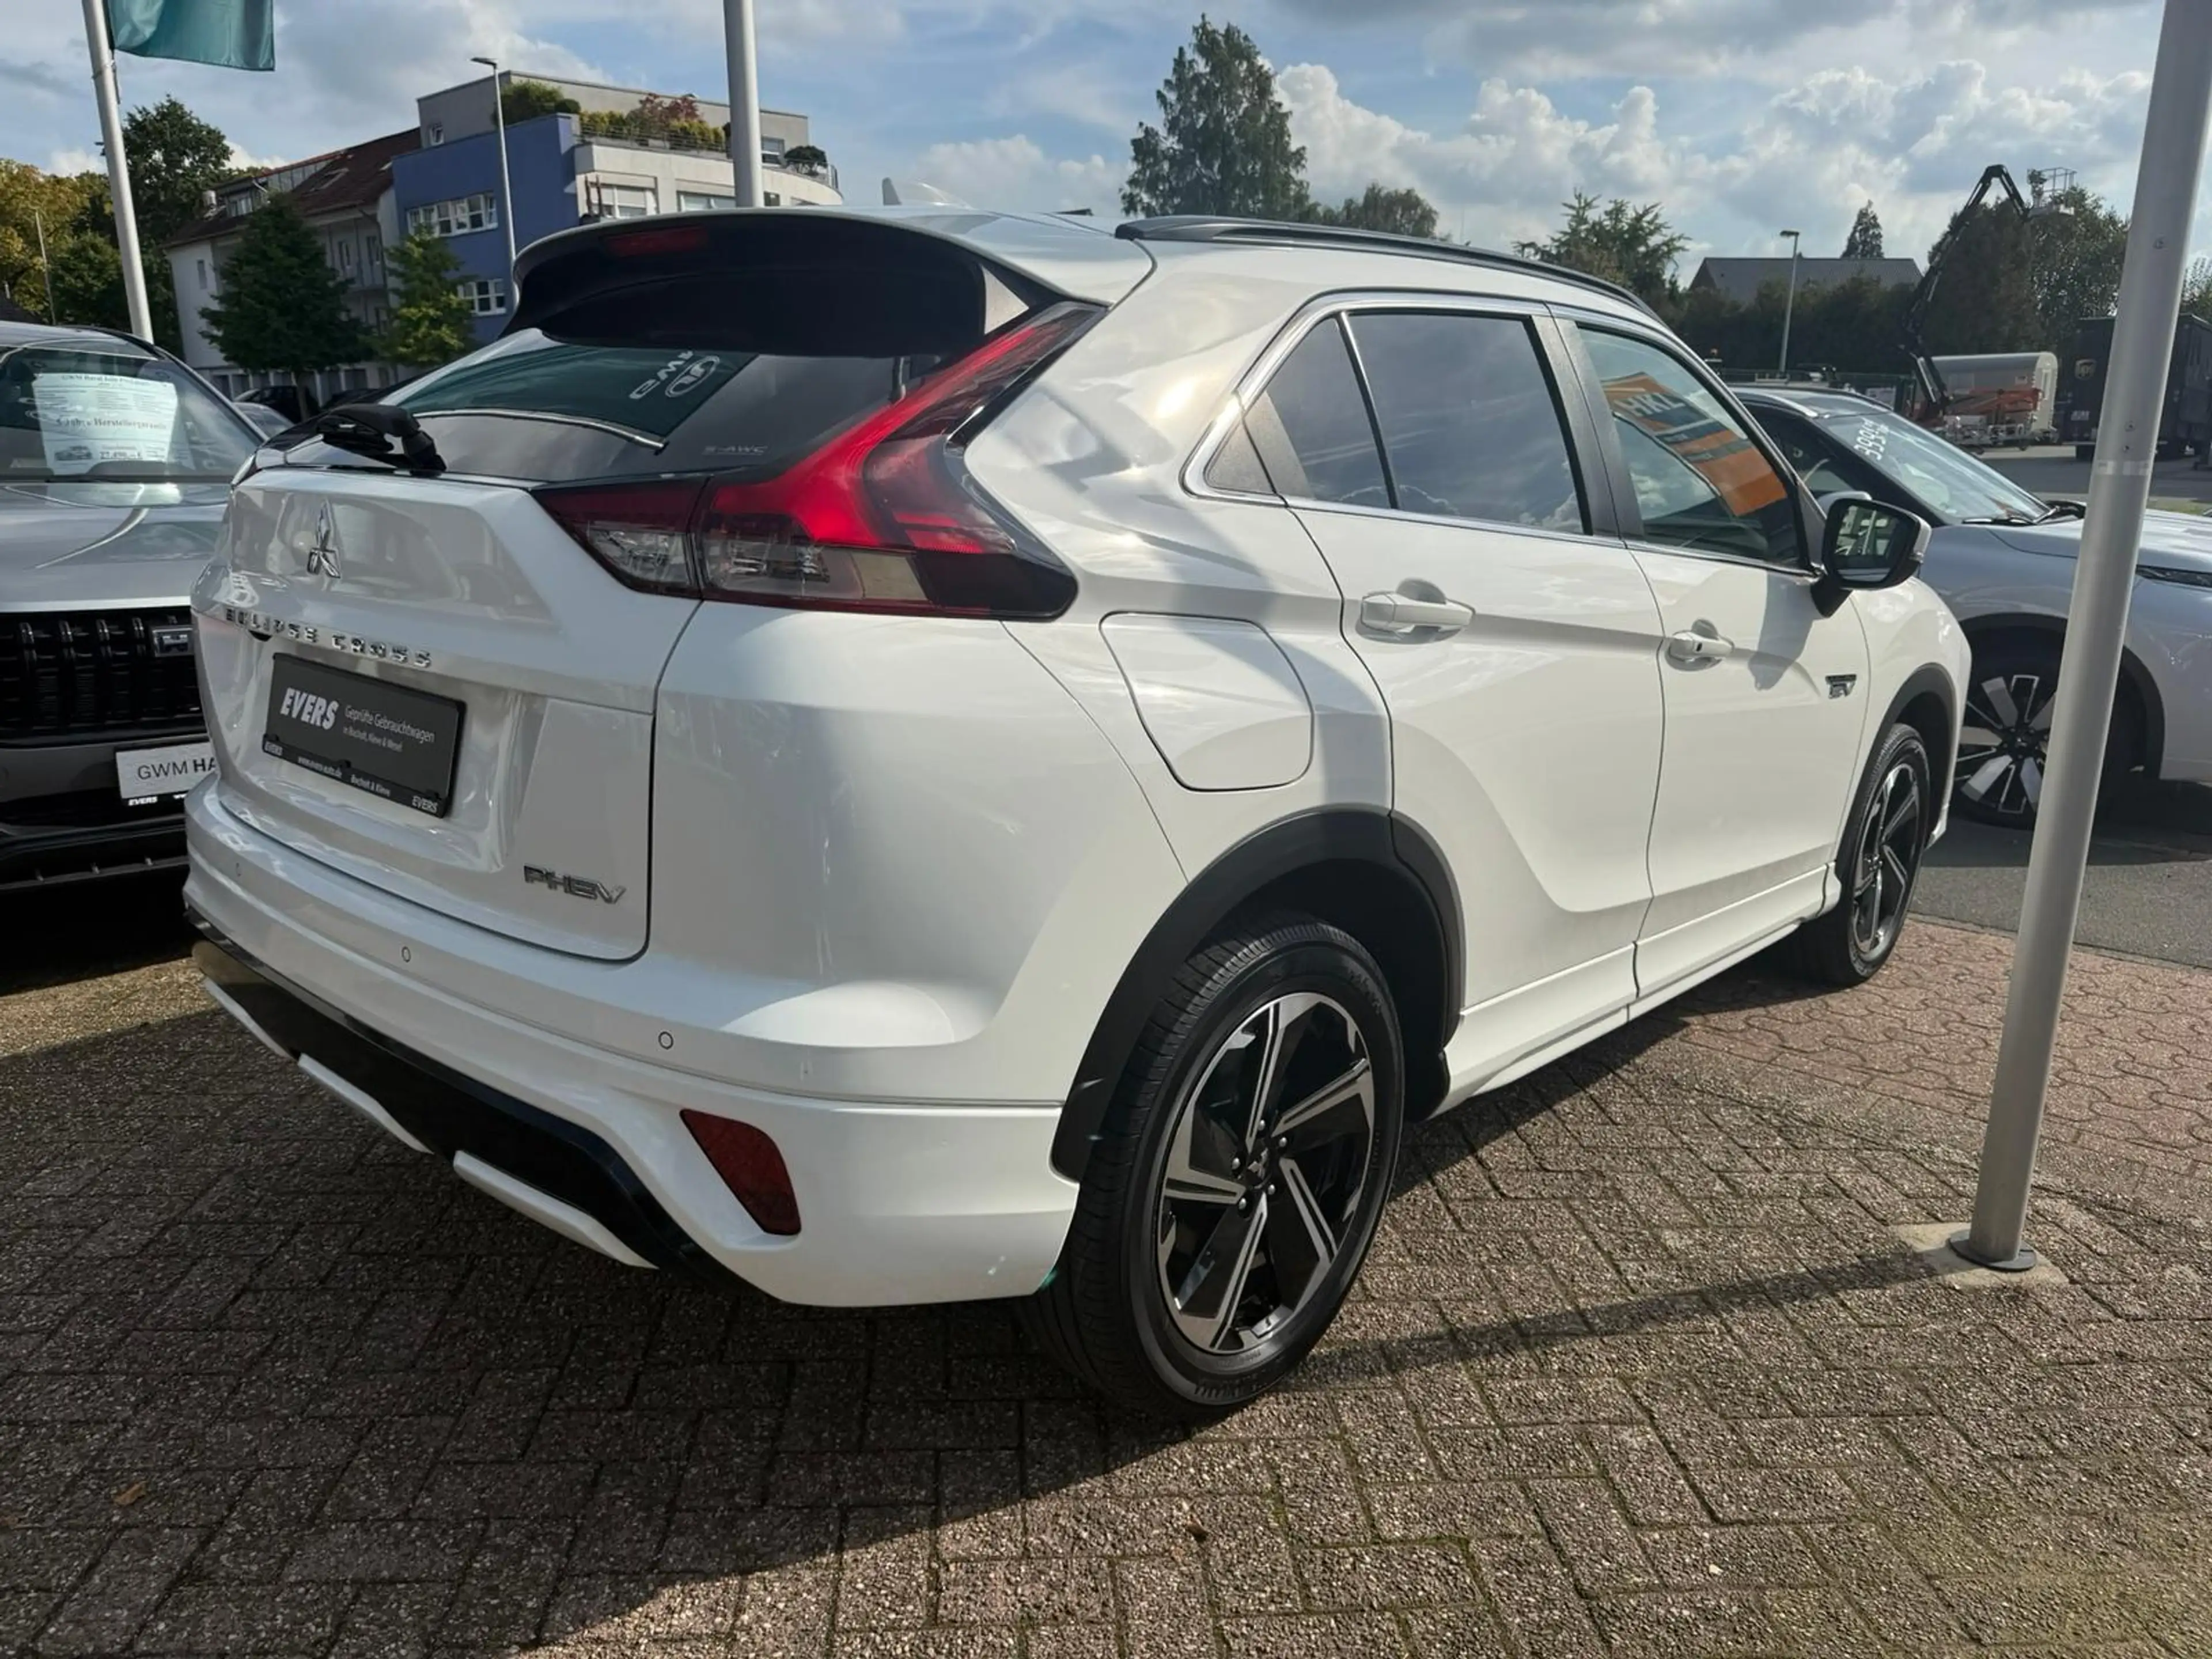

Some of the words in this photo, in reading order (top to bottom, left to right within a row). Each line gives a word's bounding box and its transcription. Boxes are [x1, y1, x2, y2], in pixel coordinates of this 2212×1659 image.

[331, 634, 431, 668] CROSS
[280, 687, 339, 730] EVERS
[137, 760, 188, 780] GWM
[128, 796, 158, 806] EVERS
[411, 795, 439, 813] EVERS
[523, 863, 627, 904] PHEV
